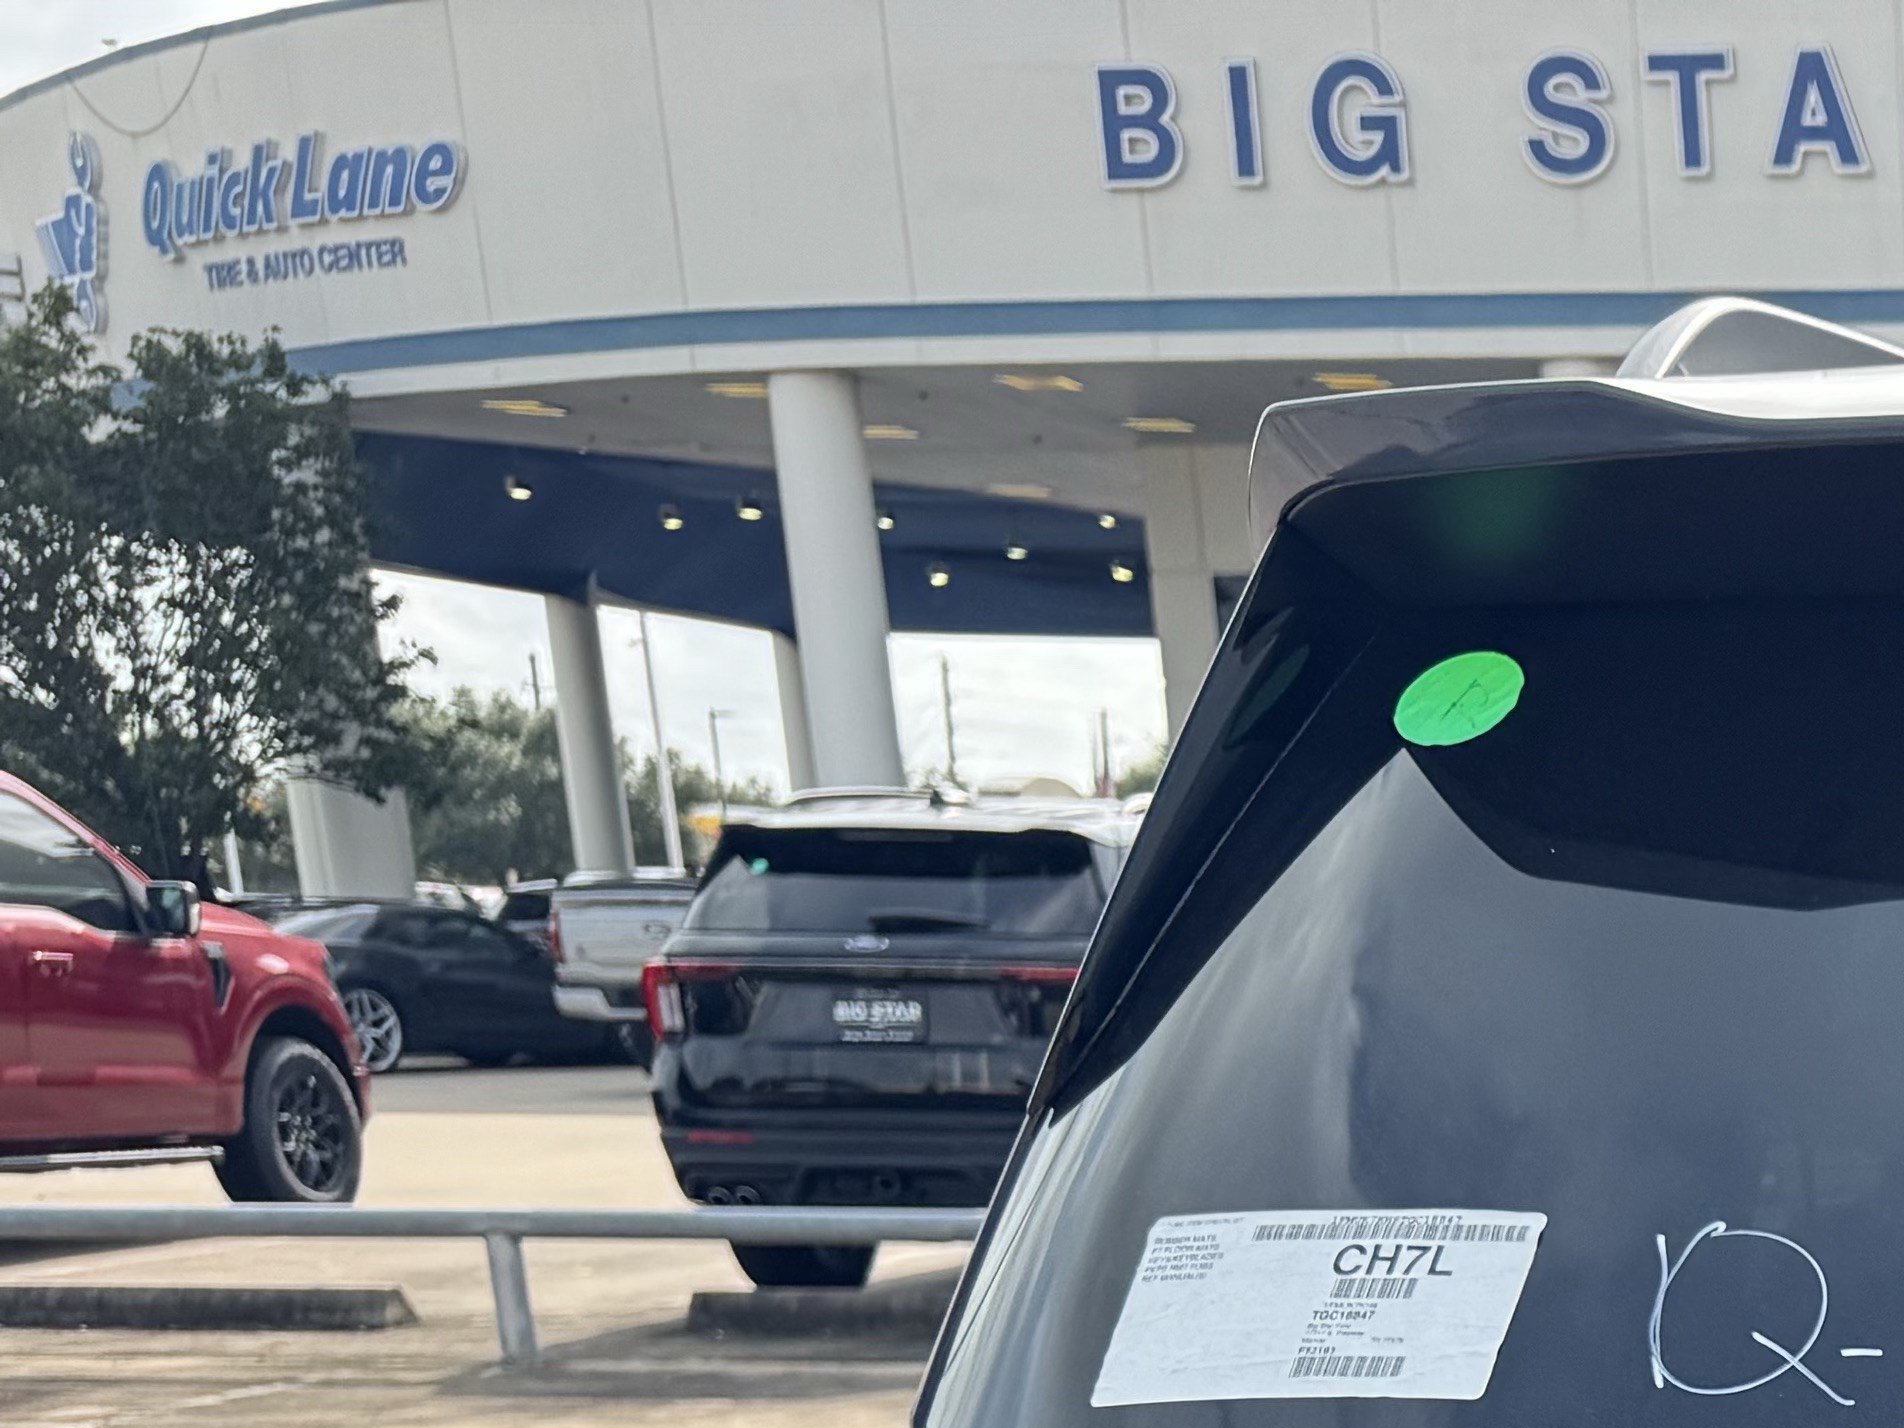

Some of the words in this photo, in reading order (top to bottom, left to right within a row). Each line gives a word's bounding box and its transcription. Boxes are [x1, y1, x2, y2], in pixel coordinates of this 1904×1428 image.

[1092, 50, 1411, 190] BIG
[142, 137, 287, 262] Quick
[290, 131, 461, 224] Lane
[204, 259, 244, 291] TIRE
[246, 257, 260, 285] &
[263, 248, 316, 286] AUTO
[318, 237, 409, 275] CENTER
[1333, 1243, 1453, 1277] CH7L
